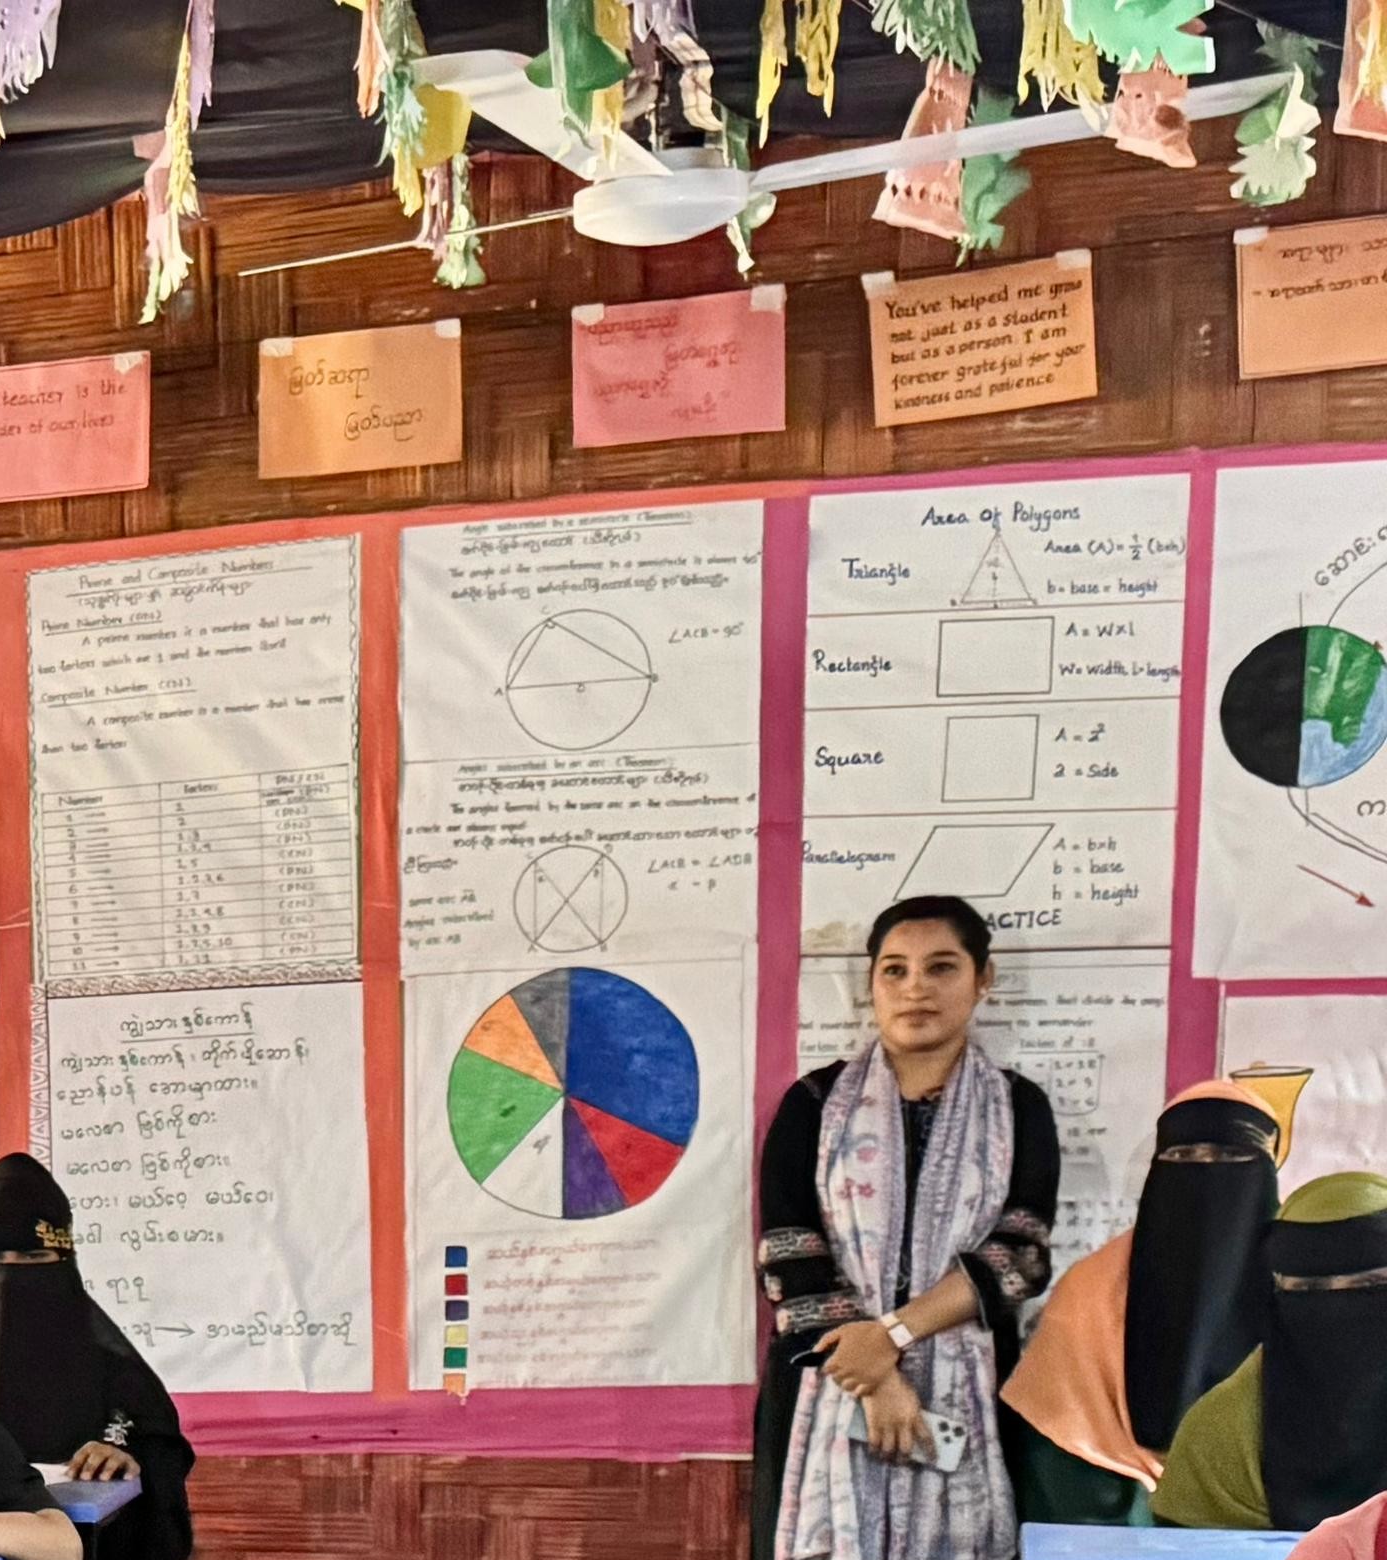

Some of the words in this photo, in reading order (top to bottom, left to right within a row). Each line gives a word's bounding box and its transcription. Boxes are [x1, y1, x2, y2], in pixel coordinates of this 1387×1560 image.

[884, 299, 943, 321] You've
[950, 283, 1010, 313] helped
[1016, 285, 1044, 301] me
[888, 328, 916, 344] not
[919, 320, 958, 344] just
[962, 318, 983, 334] as
[987, 316, 999, 329] a
[1002, 302, 1070, 328] student
[889, 349, 917, 366] but
[920, 345, 941, 361] as
[945, 343, 957, 356] a
[1040, 325, 1068, 342] am
[890, 368, 950, 393] forever
[1026, 349, 1052, 370] for
[1054, 341, 1088, 368] your
[2, 388, 64, 408] teacher
[76, 382, 90, 400] is
[100, 378, 129, 397] the
[893, 389, 951, 412] kindness
[953, 381, 984, 401] and
[987, 370, 1056, 398] patience
[28, 419, 44, 436] of
[921, 504, 971, 528] Area
[1011, 500, 1082, 533] Polygons
[1043, 539, 1082, 556] Area
[121, 569, 142, 585] and
[147, 564, 210, 586] Composite
[840, 556, 912, 587] Triangle
[1069, 578, 1101, 595] base
[812, 647, 894, 681] Rectangle
[814, 744, 885, 777] Square
[1088, 858, 1126, 875] base
[1090, 885, 1140, 908] height
[984, 908, 1063, 931] ACTICE
